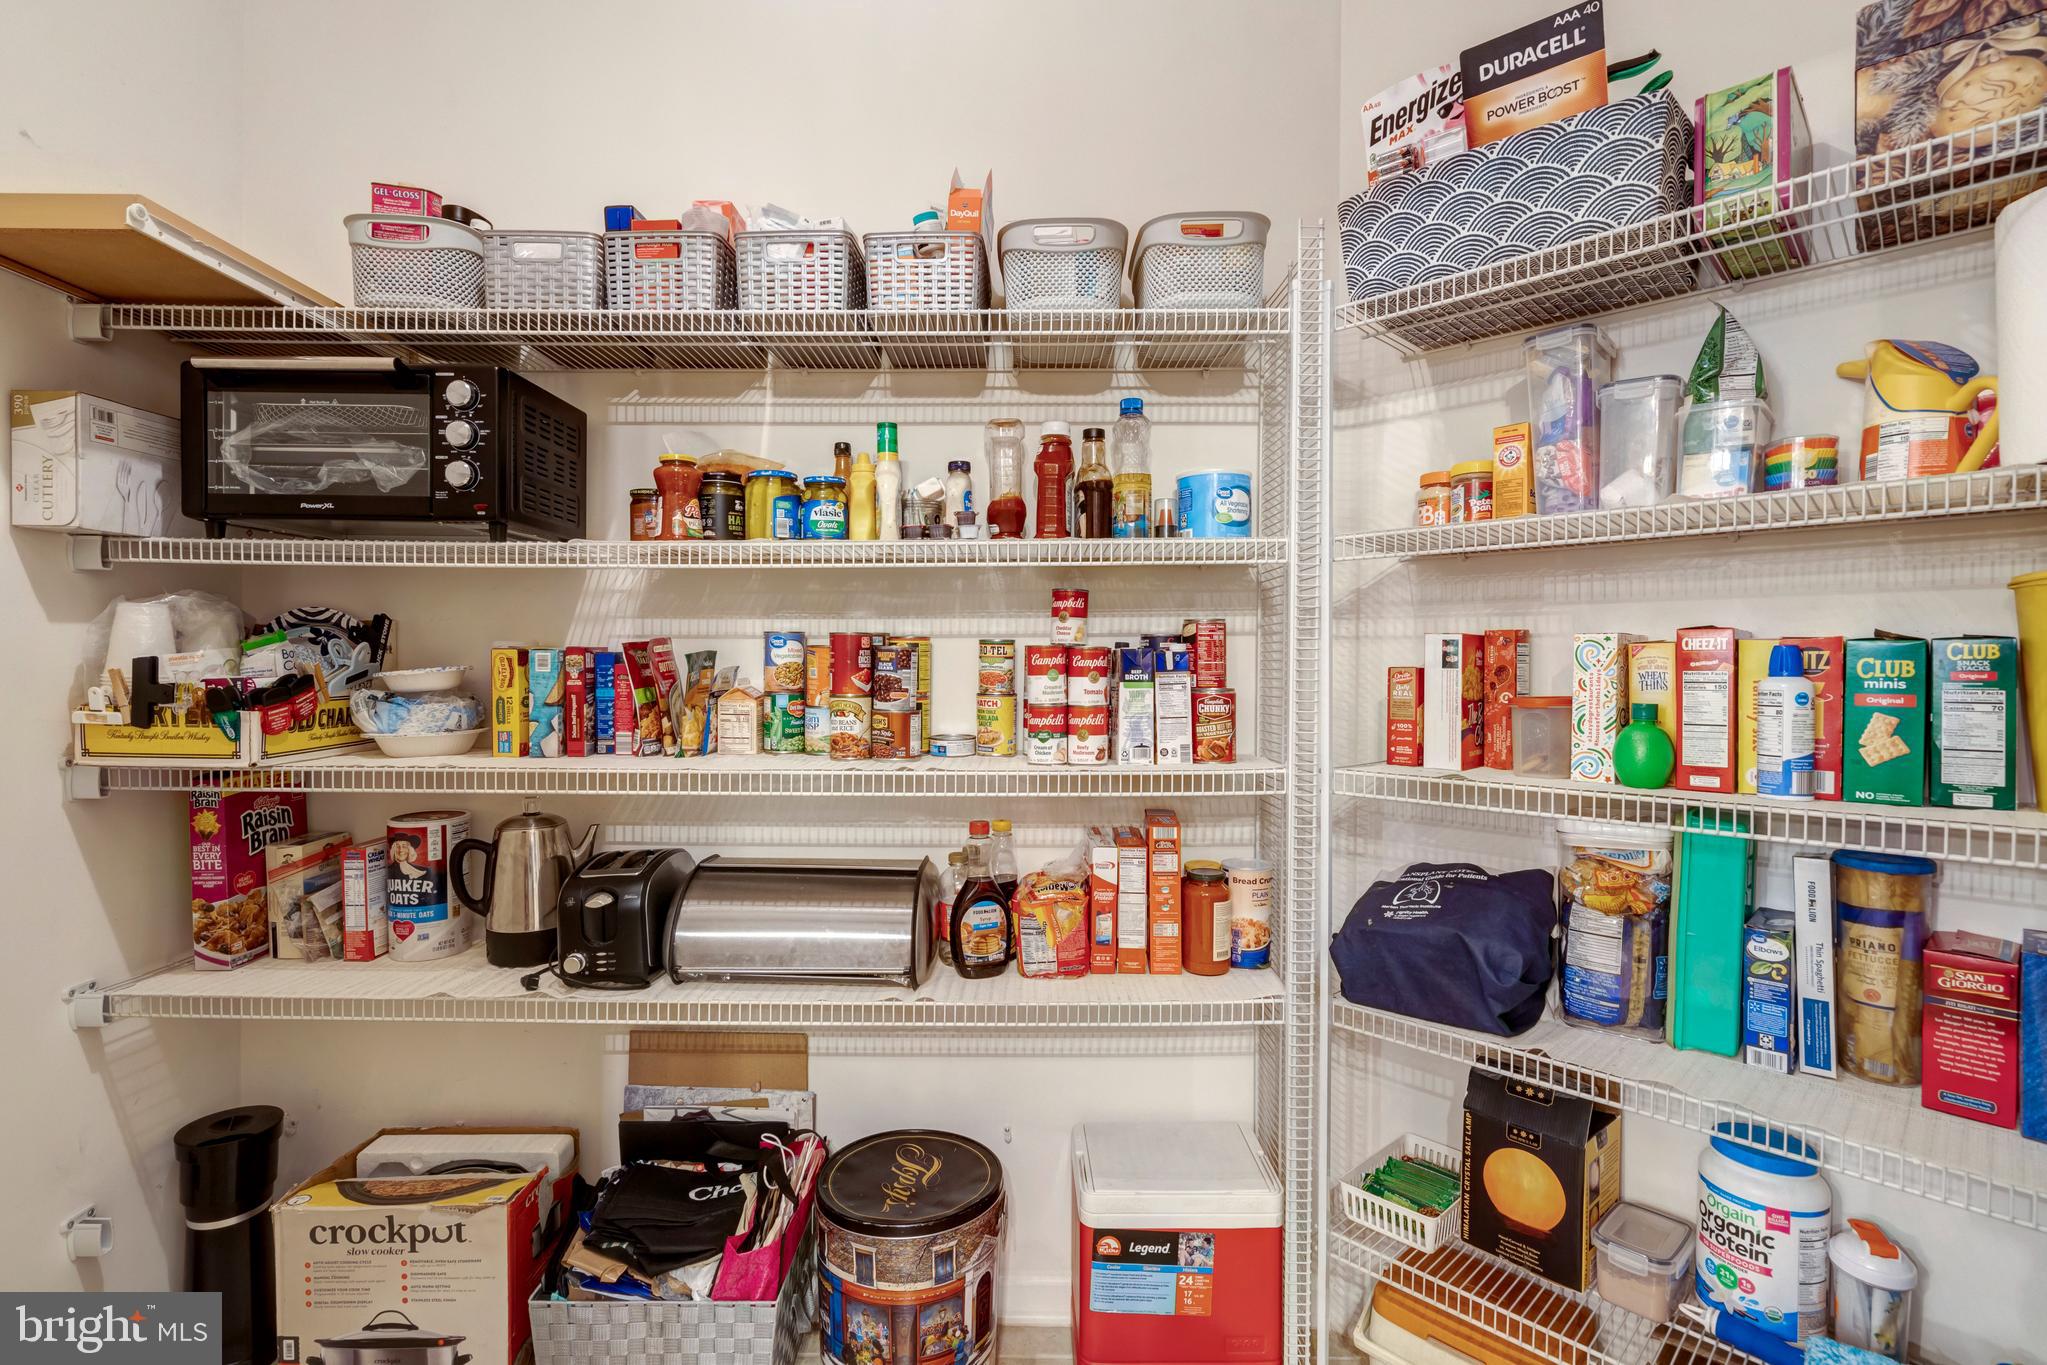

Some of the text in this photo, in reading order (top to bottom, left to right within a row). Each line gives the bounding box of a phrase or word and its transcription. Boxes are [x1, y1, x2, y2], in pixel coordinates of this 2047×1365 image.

[1554, 2, 1600, 28] AAA 40
[1479, 28, 1586, 82] DURACELL
[1487, 79, 1580, 121] POWER BOOST
[1363, 103, 1374, 112] AA
[1370, 71, 1463, 147] Energize
[1389, 124, 1415, 145] MAX
[13, 394, 24, 415] 390
[41, 455, 53, 521] CUTLERY
[300, 502, 334, 510] PowerXL
[1472, 503, 1492, 513] Pan
[813, 508, 841, 518] vlasic
[1052, 597, 1085, 610] ampbell's
[1947, 642, 2000, 661] CLUB
[1031, 653, 1066, 666] Campbe
[1073, 656, 1108, 669] Campbe
[1803, 651, 1830, 669] ITZ
[1856, 657, 1915, 678] CLUB
[1638, 671, 1668, 680] WHEAT
[1639, 680, 1668, 691] THINS
[1864, 679, 1907, 689] minis
[1866, 696, 1904, 705] Original
[1199, 704, 1230, 713] CHUNKY
[107, 729, 133, 742] Kentucky
[161, 731, 184, 740] Bourbon
[185, 732, 211, 743] Whiskey
[191, 790, 220, 800] Raisin
[1856, 791, 1874, 799] NO
[194, 799, 217, 808] Bran
[242, 807, 293, 838] Raisin
[250, 827, 290, 855] Bran
[193, 852, 221, 860] EVERY
[368, 855, 385, 864] WHEAT
[192, 860, 223, 870] BITE
[1232, 877, 1272, 885] Bread Cru
[390, 893, 419, 905] OATS
[1808, 881, 1816, 922] FOOD LION
[418, 910, 434, 918] OATS
[1754, 945, 1783, 956] Elbows
[1850, 937, 1896, 952] PRIANO
[1814, 942, 1825, 994] Thin Spaghetti
[1955, 971, 1985, 982] SAN
[1937, 977, 2004, 993] GIORGIO
[1707, 1193, 1756, 1227] Orgain
[1699, 1200, 1775, 1249] Organic
[309, 1215, 467, 1253] crockpot
[1701, 1218, 1769, 1264] Protein
[347, 1246, 405, 1256] slow cooker
[1129, 1242, 1170, 1255] Legend
[1710, 1244, 1761, 1272] SUPERFOODS
[1179, 1276, 1194, 1285] 24
